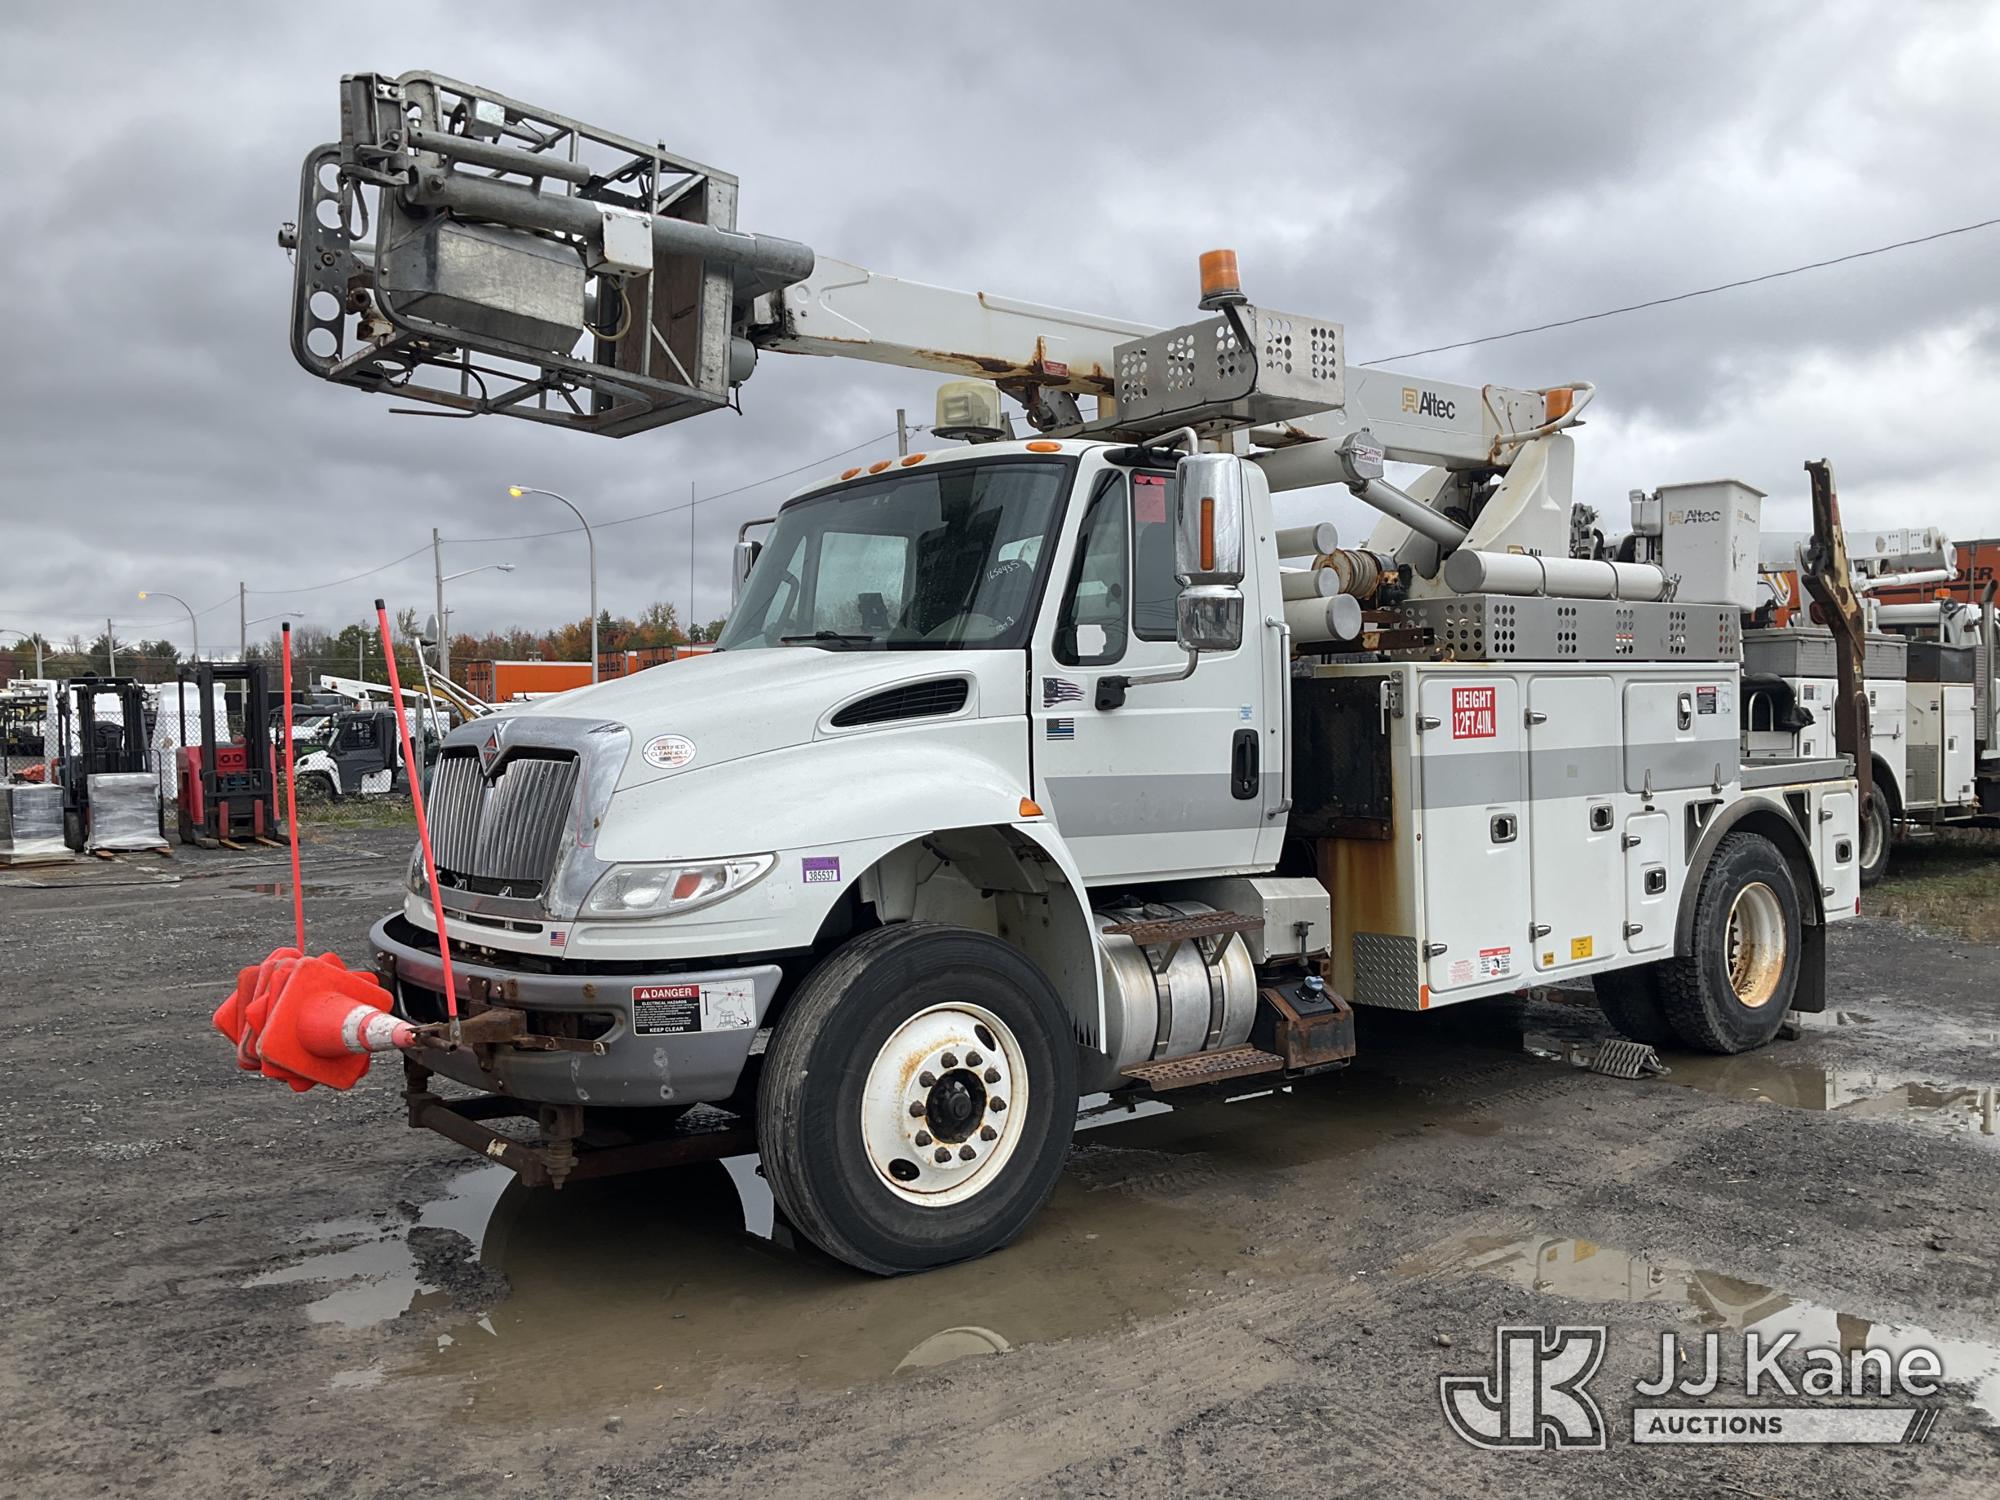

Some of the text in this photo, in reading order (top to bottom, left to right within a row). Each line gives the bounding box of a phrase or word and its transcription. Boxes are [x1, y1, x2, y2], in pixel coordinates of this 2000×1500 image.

[1418, 391, 1456, 420] Altec
[1684, 509, 1721, 525] Altec
[1456, 690, 1492, 708] HEIGHT
[808, 871, 834, 881] 385537
[651, 987, 692, 998] DANGER
